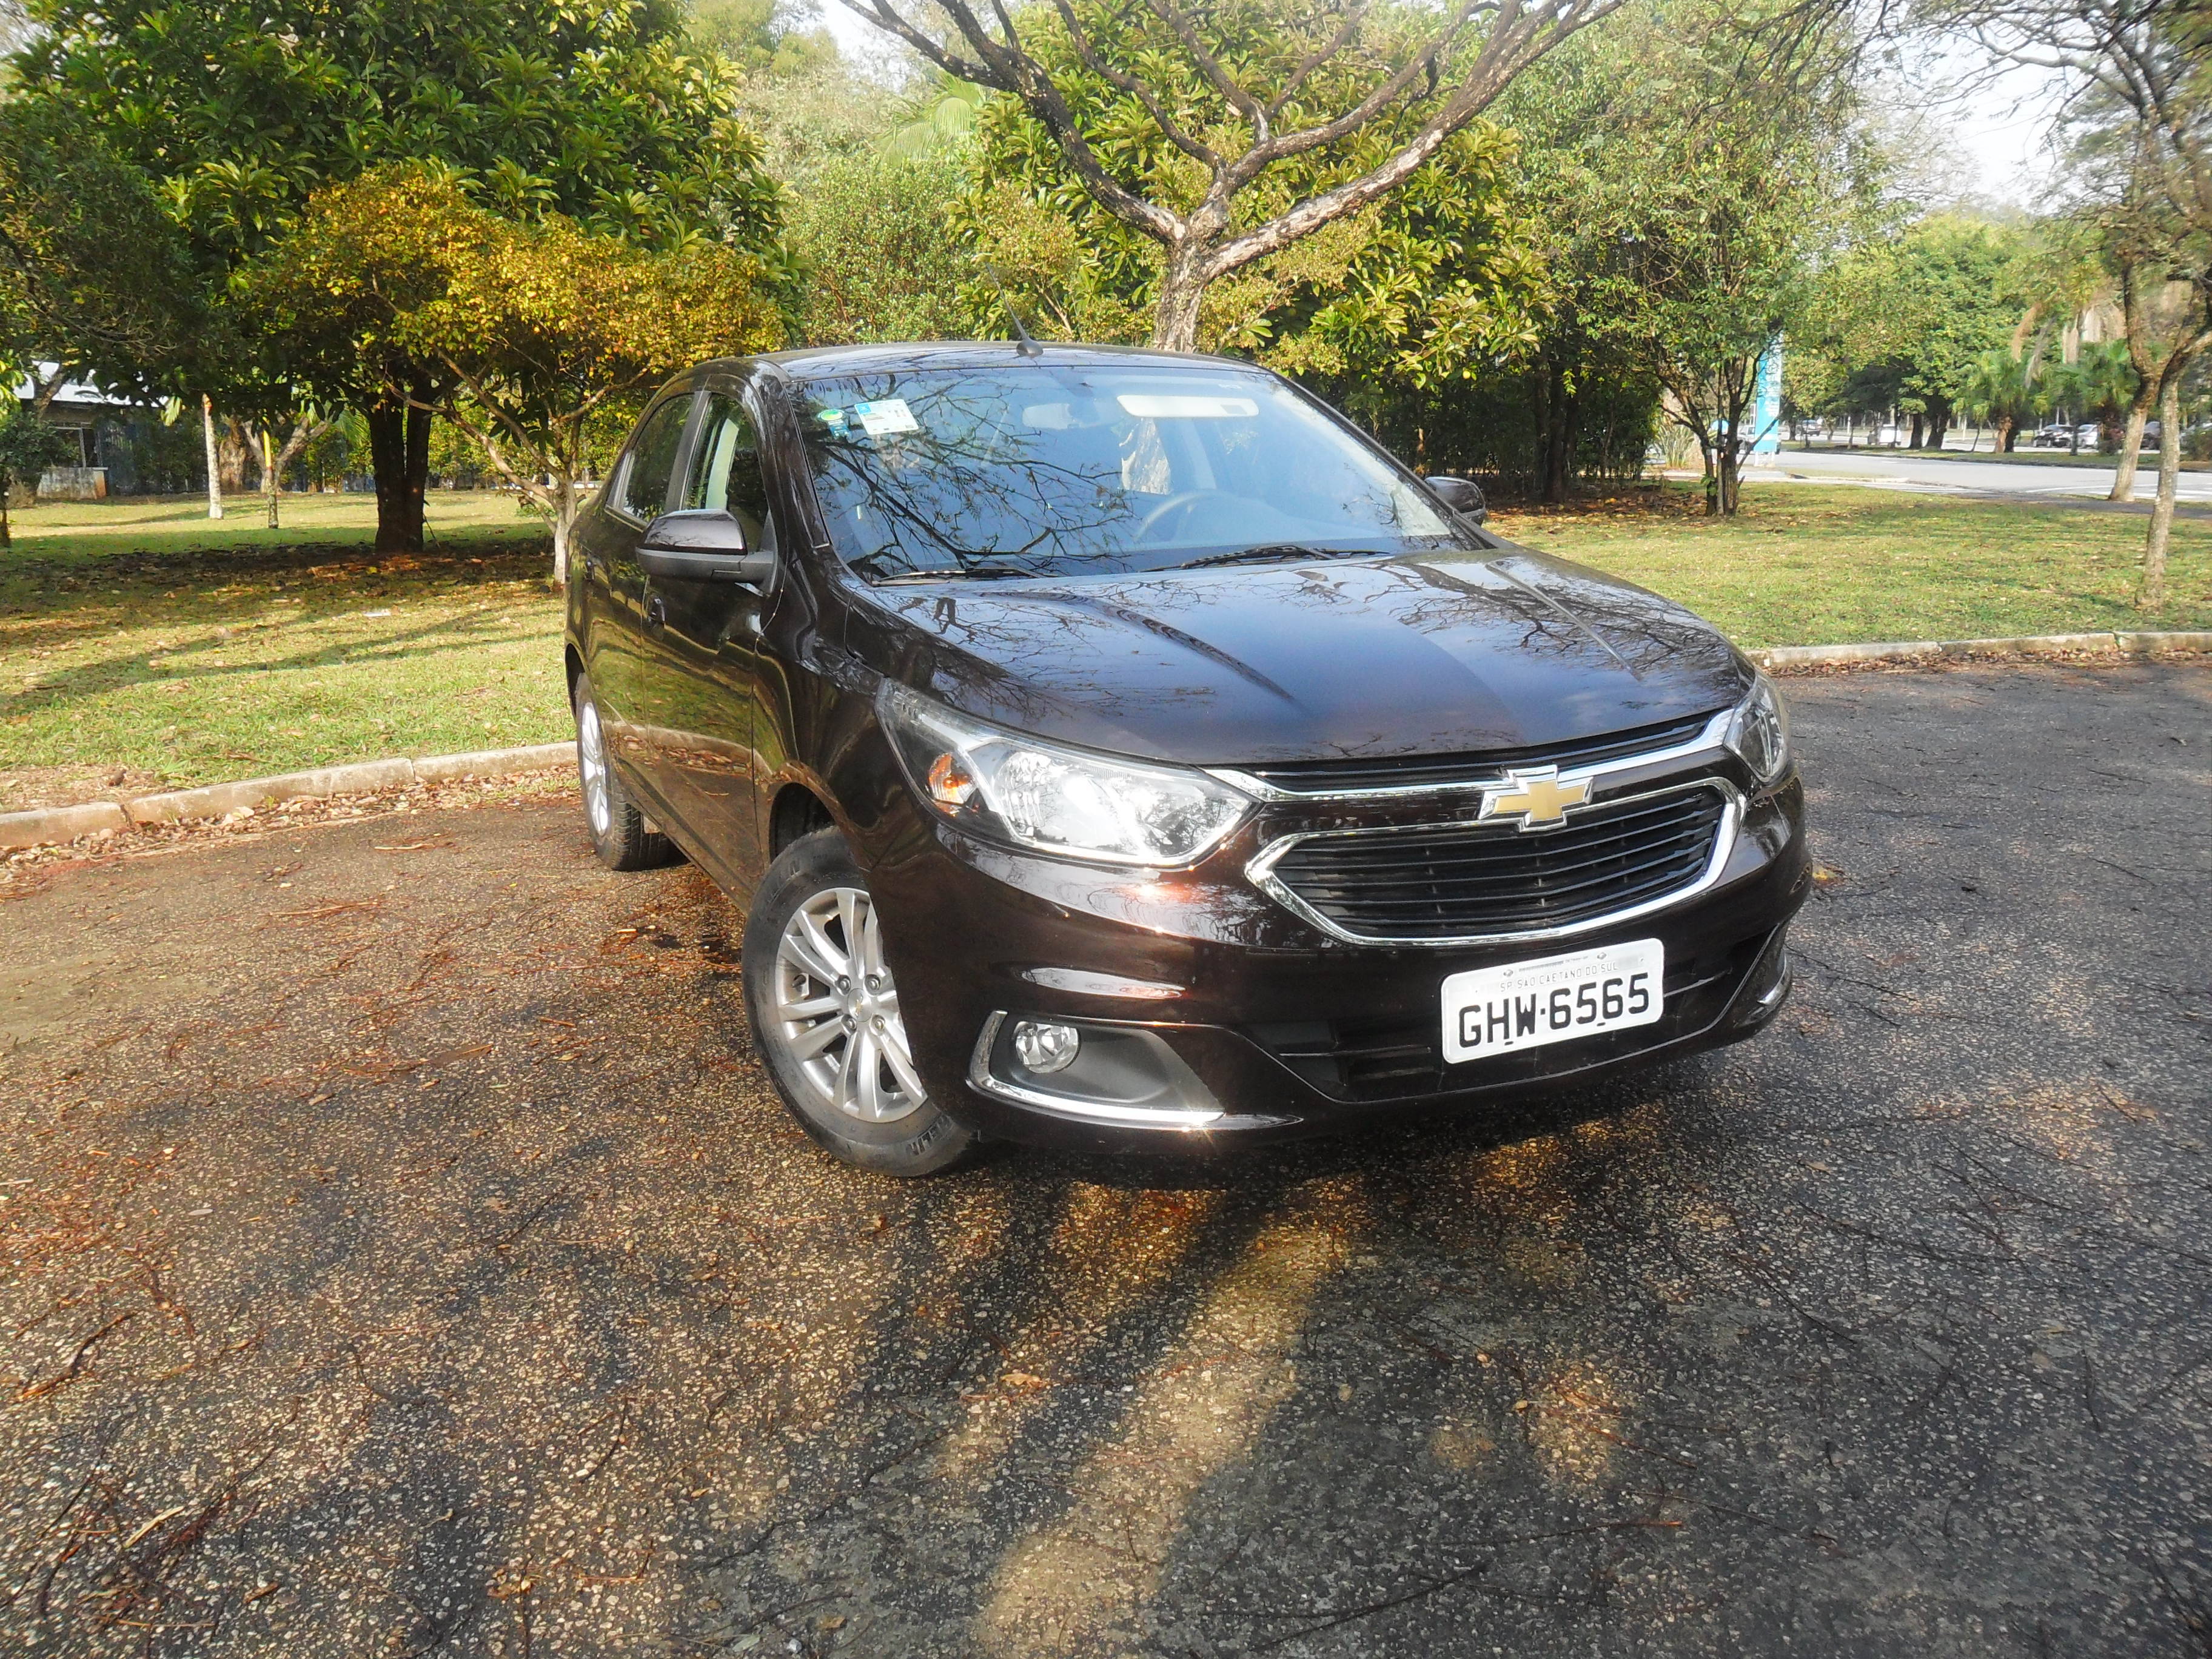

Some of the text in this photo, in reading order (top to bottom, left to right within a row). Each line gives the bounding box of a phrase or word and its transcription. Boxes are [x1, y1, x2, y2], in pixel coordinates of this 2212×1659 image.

[1500, 982, 1512, 992] SP
[1539, 969, 1582, 985] CAETANO
[1586, 965, 1597, 975] DO
[1601, 962, 1618, 973] SUL
